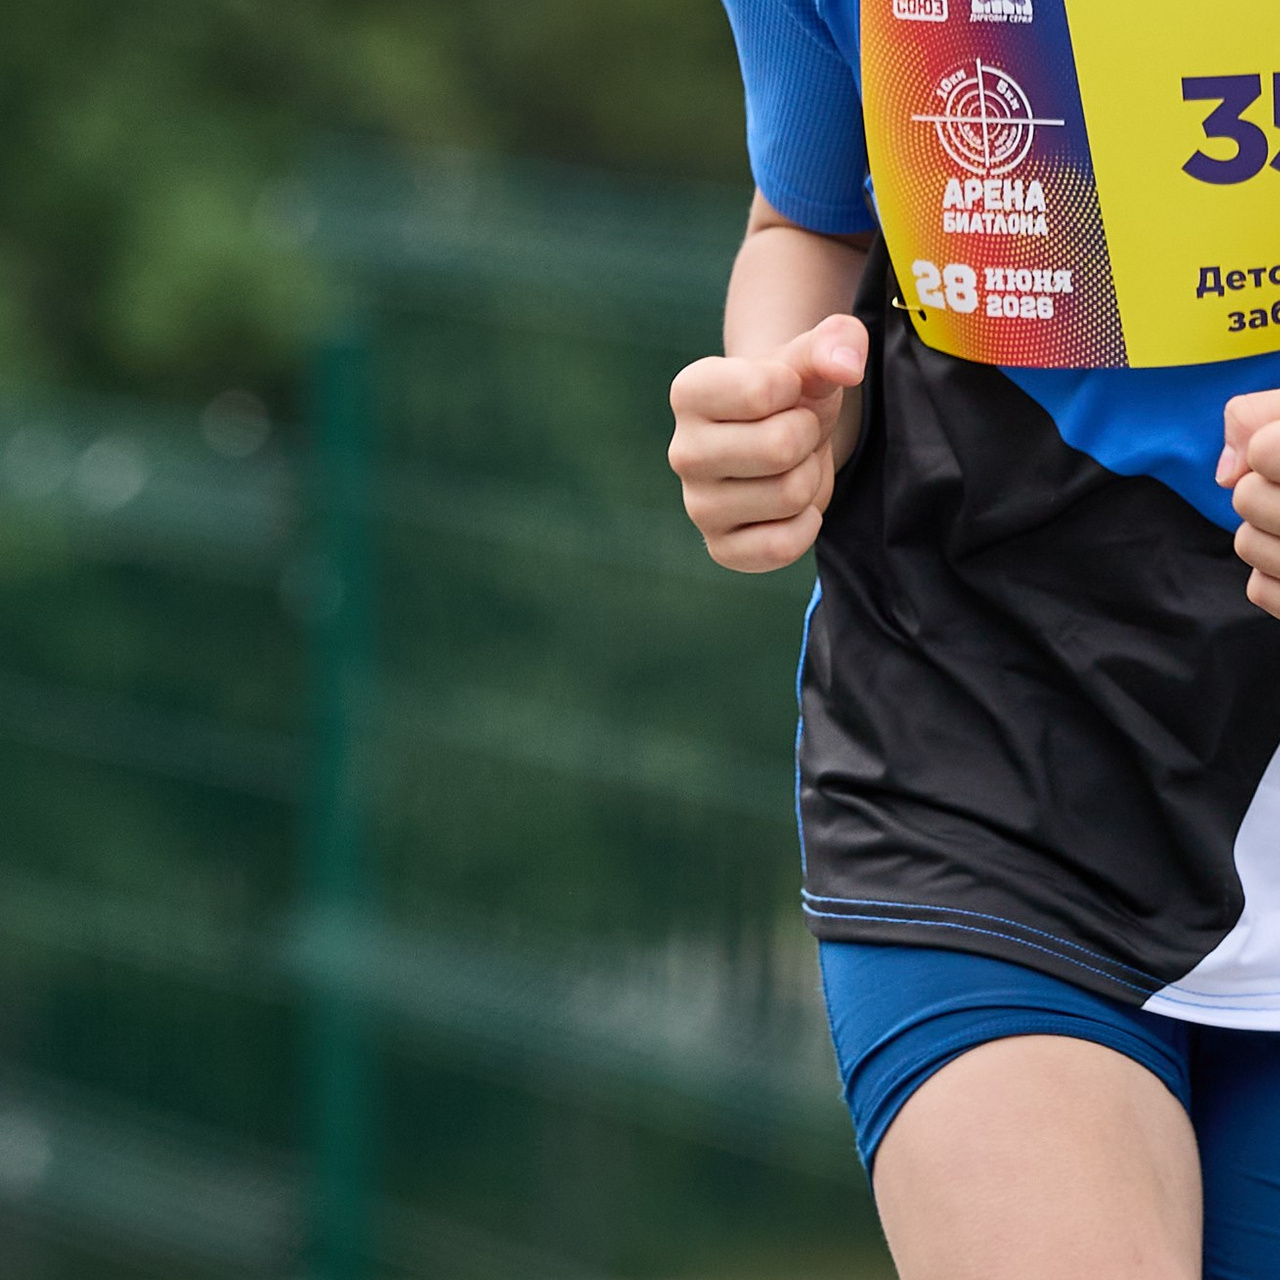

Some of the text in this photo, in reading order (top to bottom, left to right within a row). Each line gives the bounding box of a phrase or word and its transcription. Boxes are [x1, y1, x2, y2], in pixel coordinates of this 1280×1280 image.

[943, 178, 1046, 212] АРЕНА
[943, 211, 1048, 236] БИАТЛОНА
[912, 260, 979, 313] 28
[986, 295, 1054, 319] 2026
